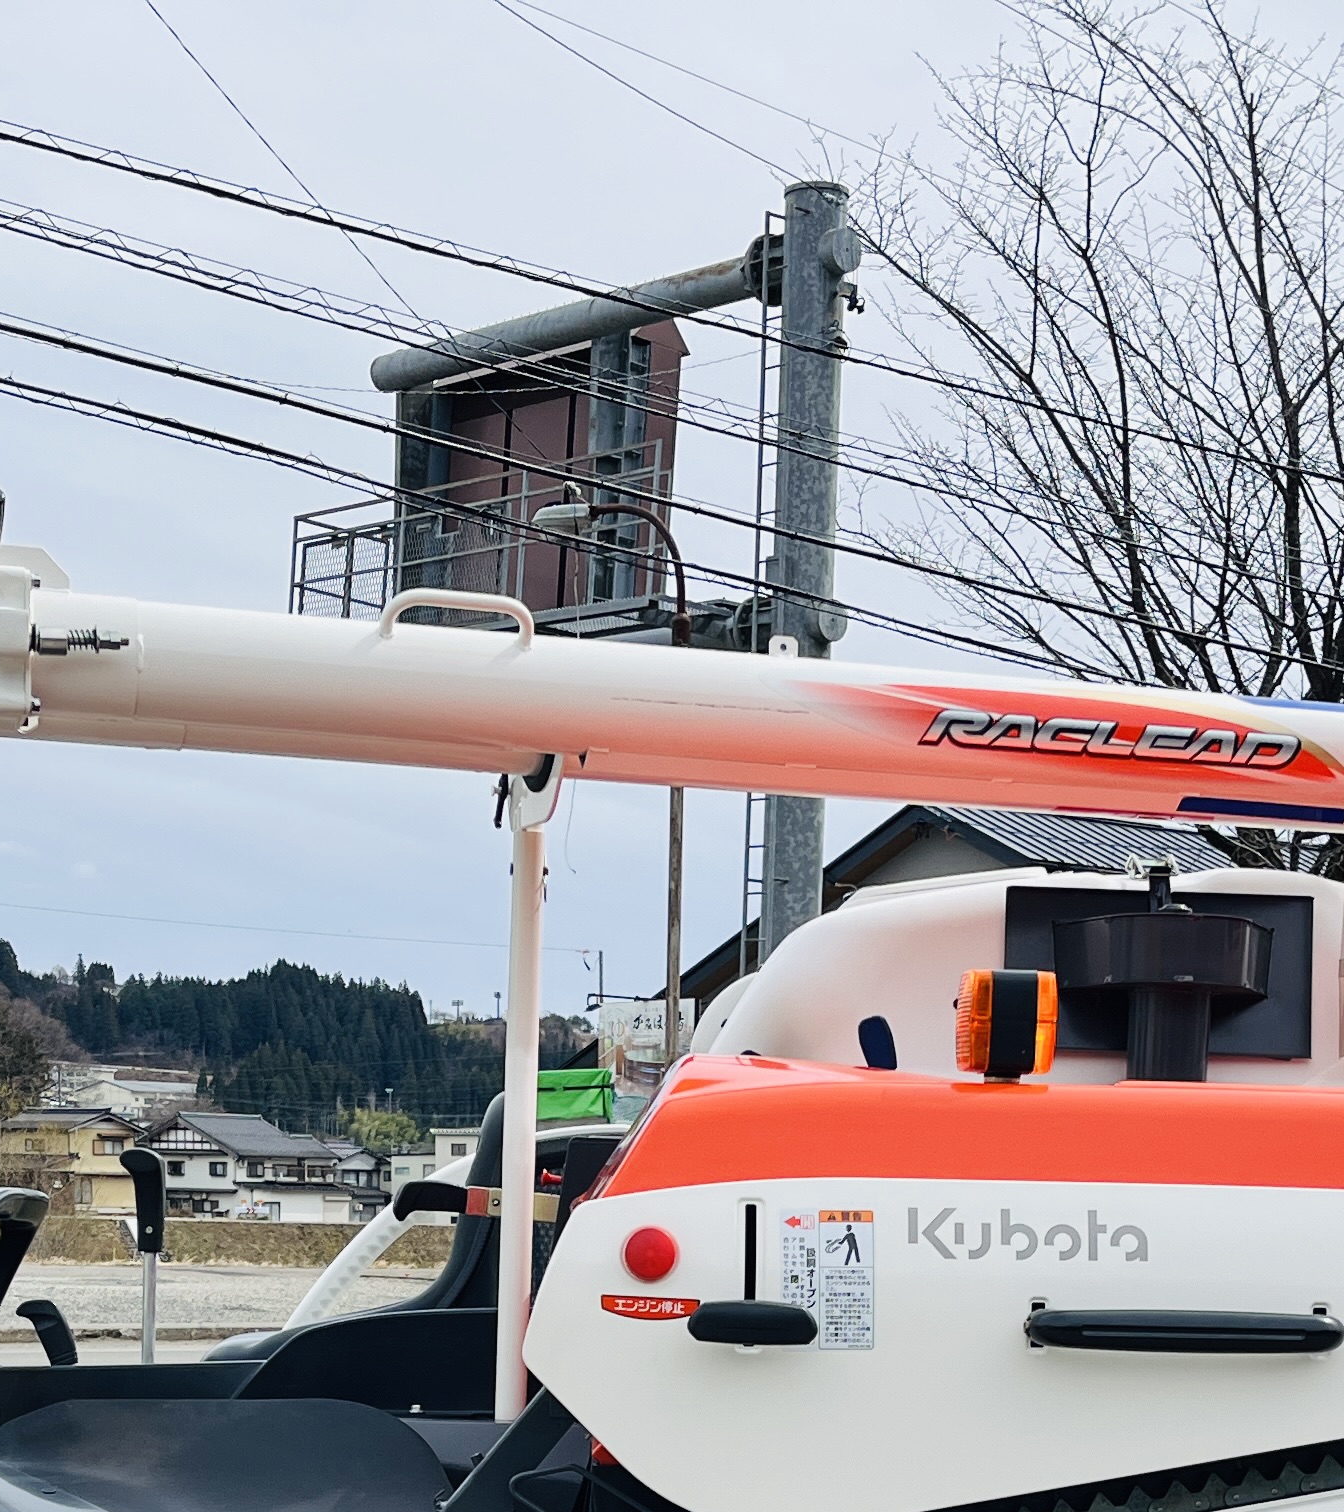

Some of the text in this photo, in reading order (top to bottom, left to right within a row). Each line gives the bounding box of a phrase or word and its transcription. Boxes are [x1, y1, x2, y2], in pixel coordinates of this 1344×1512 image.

[917, 708, 1303, 770] RACLEAD
[908, 1207, 1149, 1262] Kubota
[614, 1299, 685, 1315] エンジン停止
